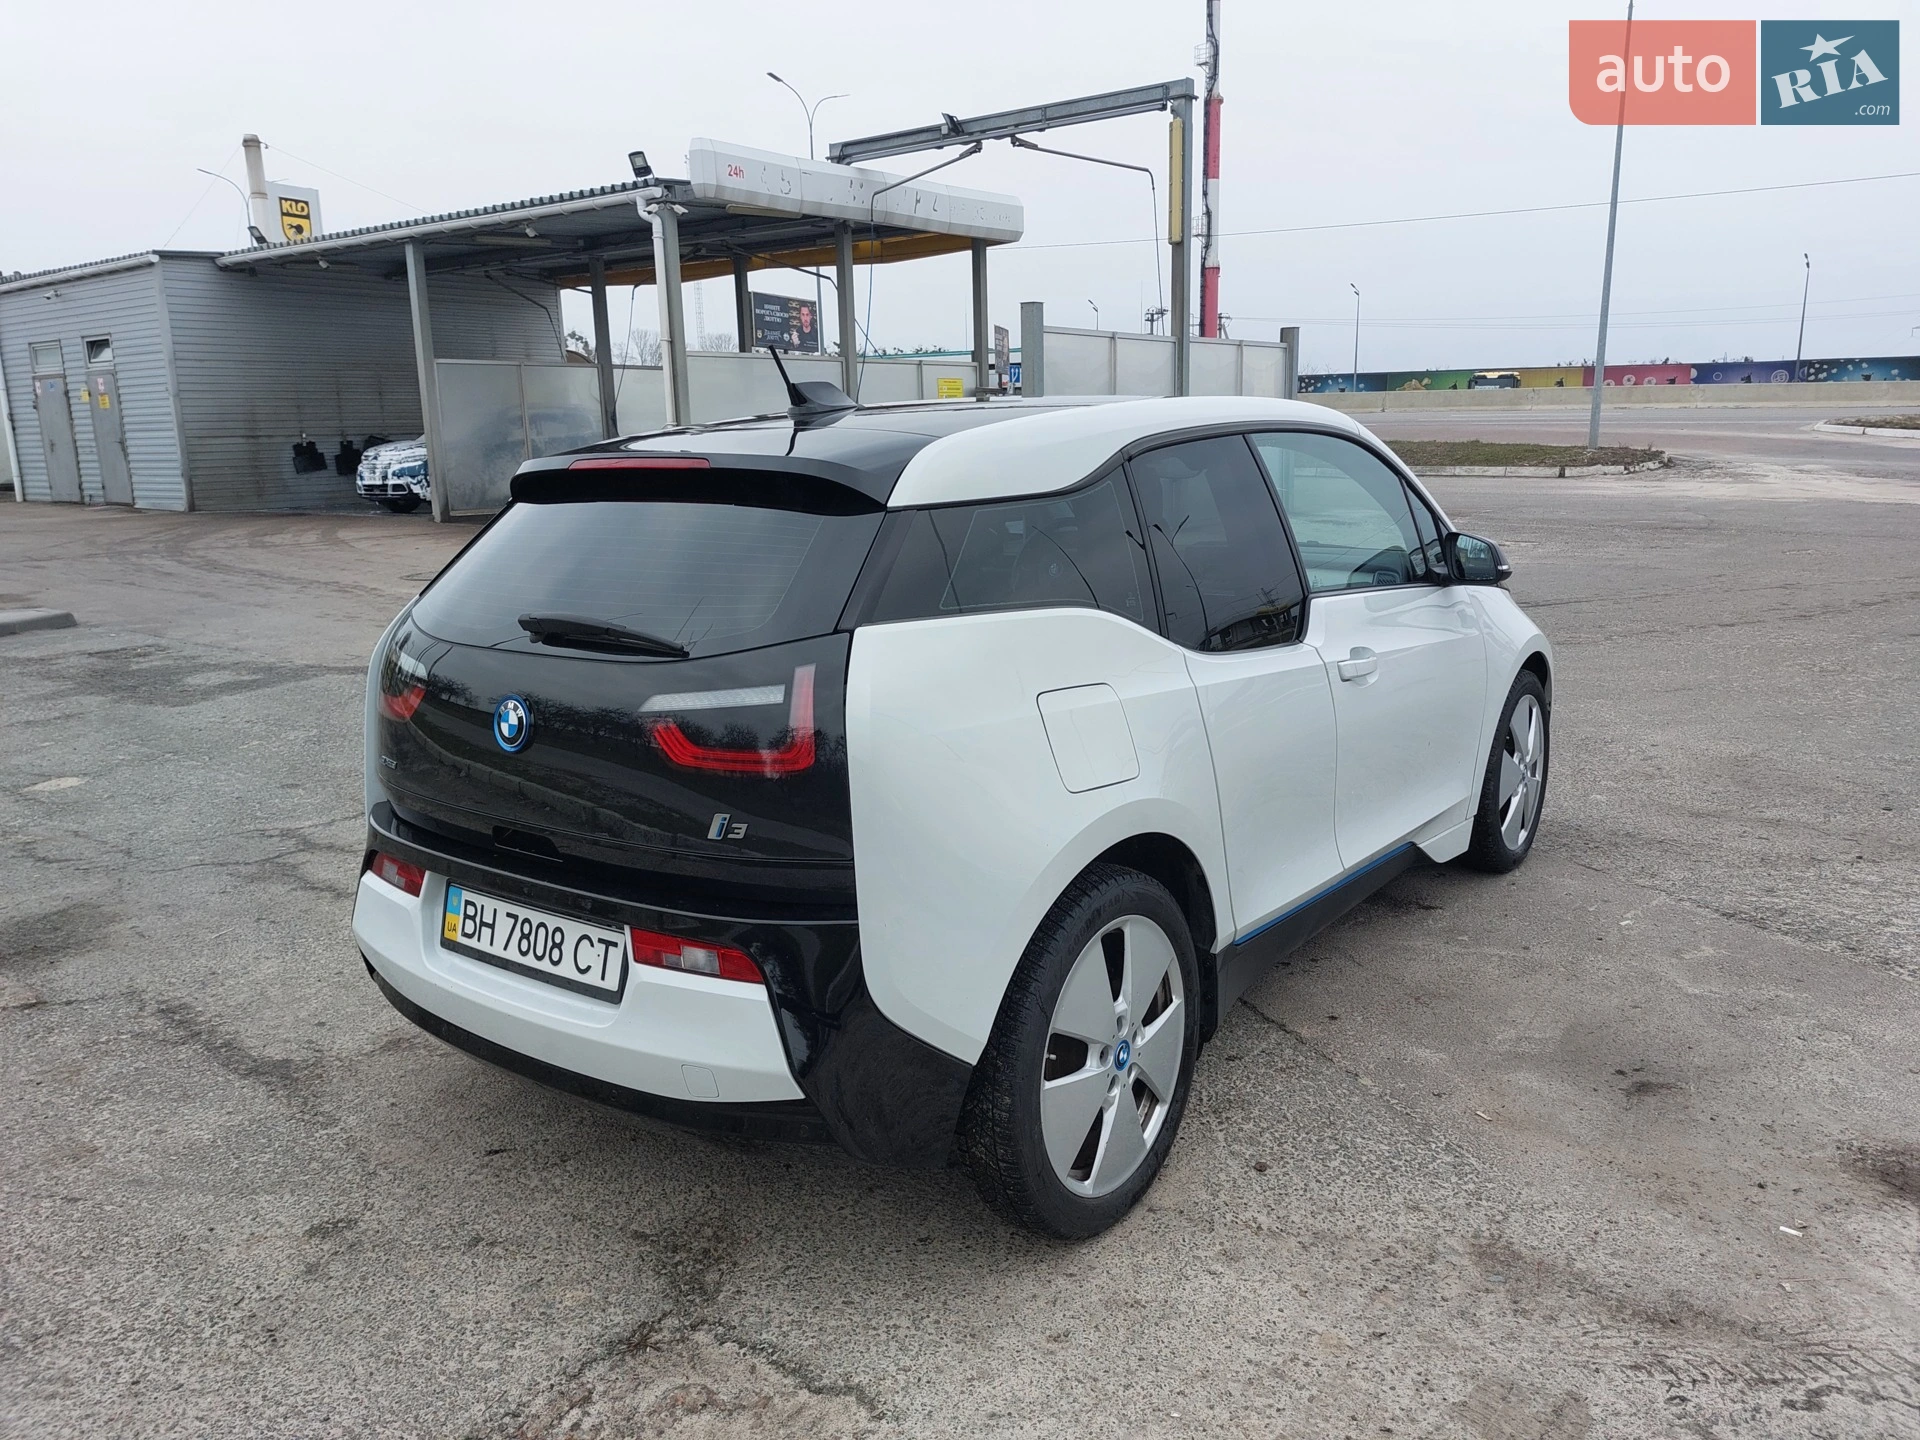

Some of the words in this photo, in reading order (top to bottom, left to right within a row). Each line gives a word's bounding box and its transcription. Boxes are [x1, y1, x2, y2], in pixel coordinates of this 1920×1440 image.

[727, 164, 745, 179] 24h
[281, 199, 309, 216] KLO
[499, 701, 523, 718] BMW
[707, 813, 749, 840] i3
[447, 921, 457, 934] UA
[461, 899, 497, 947] BH
[503, 911, 565, 967] 7808
[573, 934, 619, 981] CT
